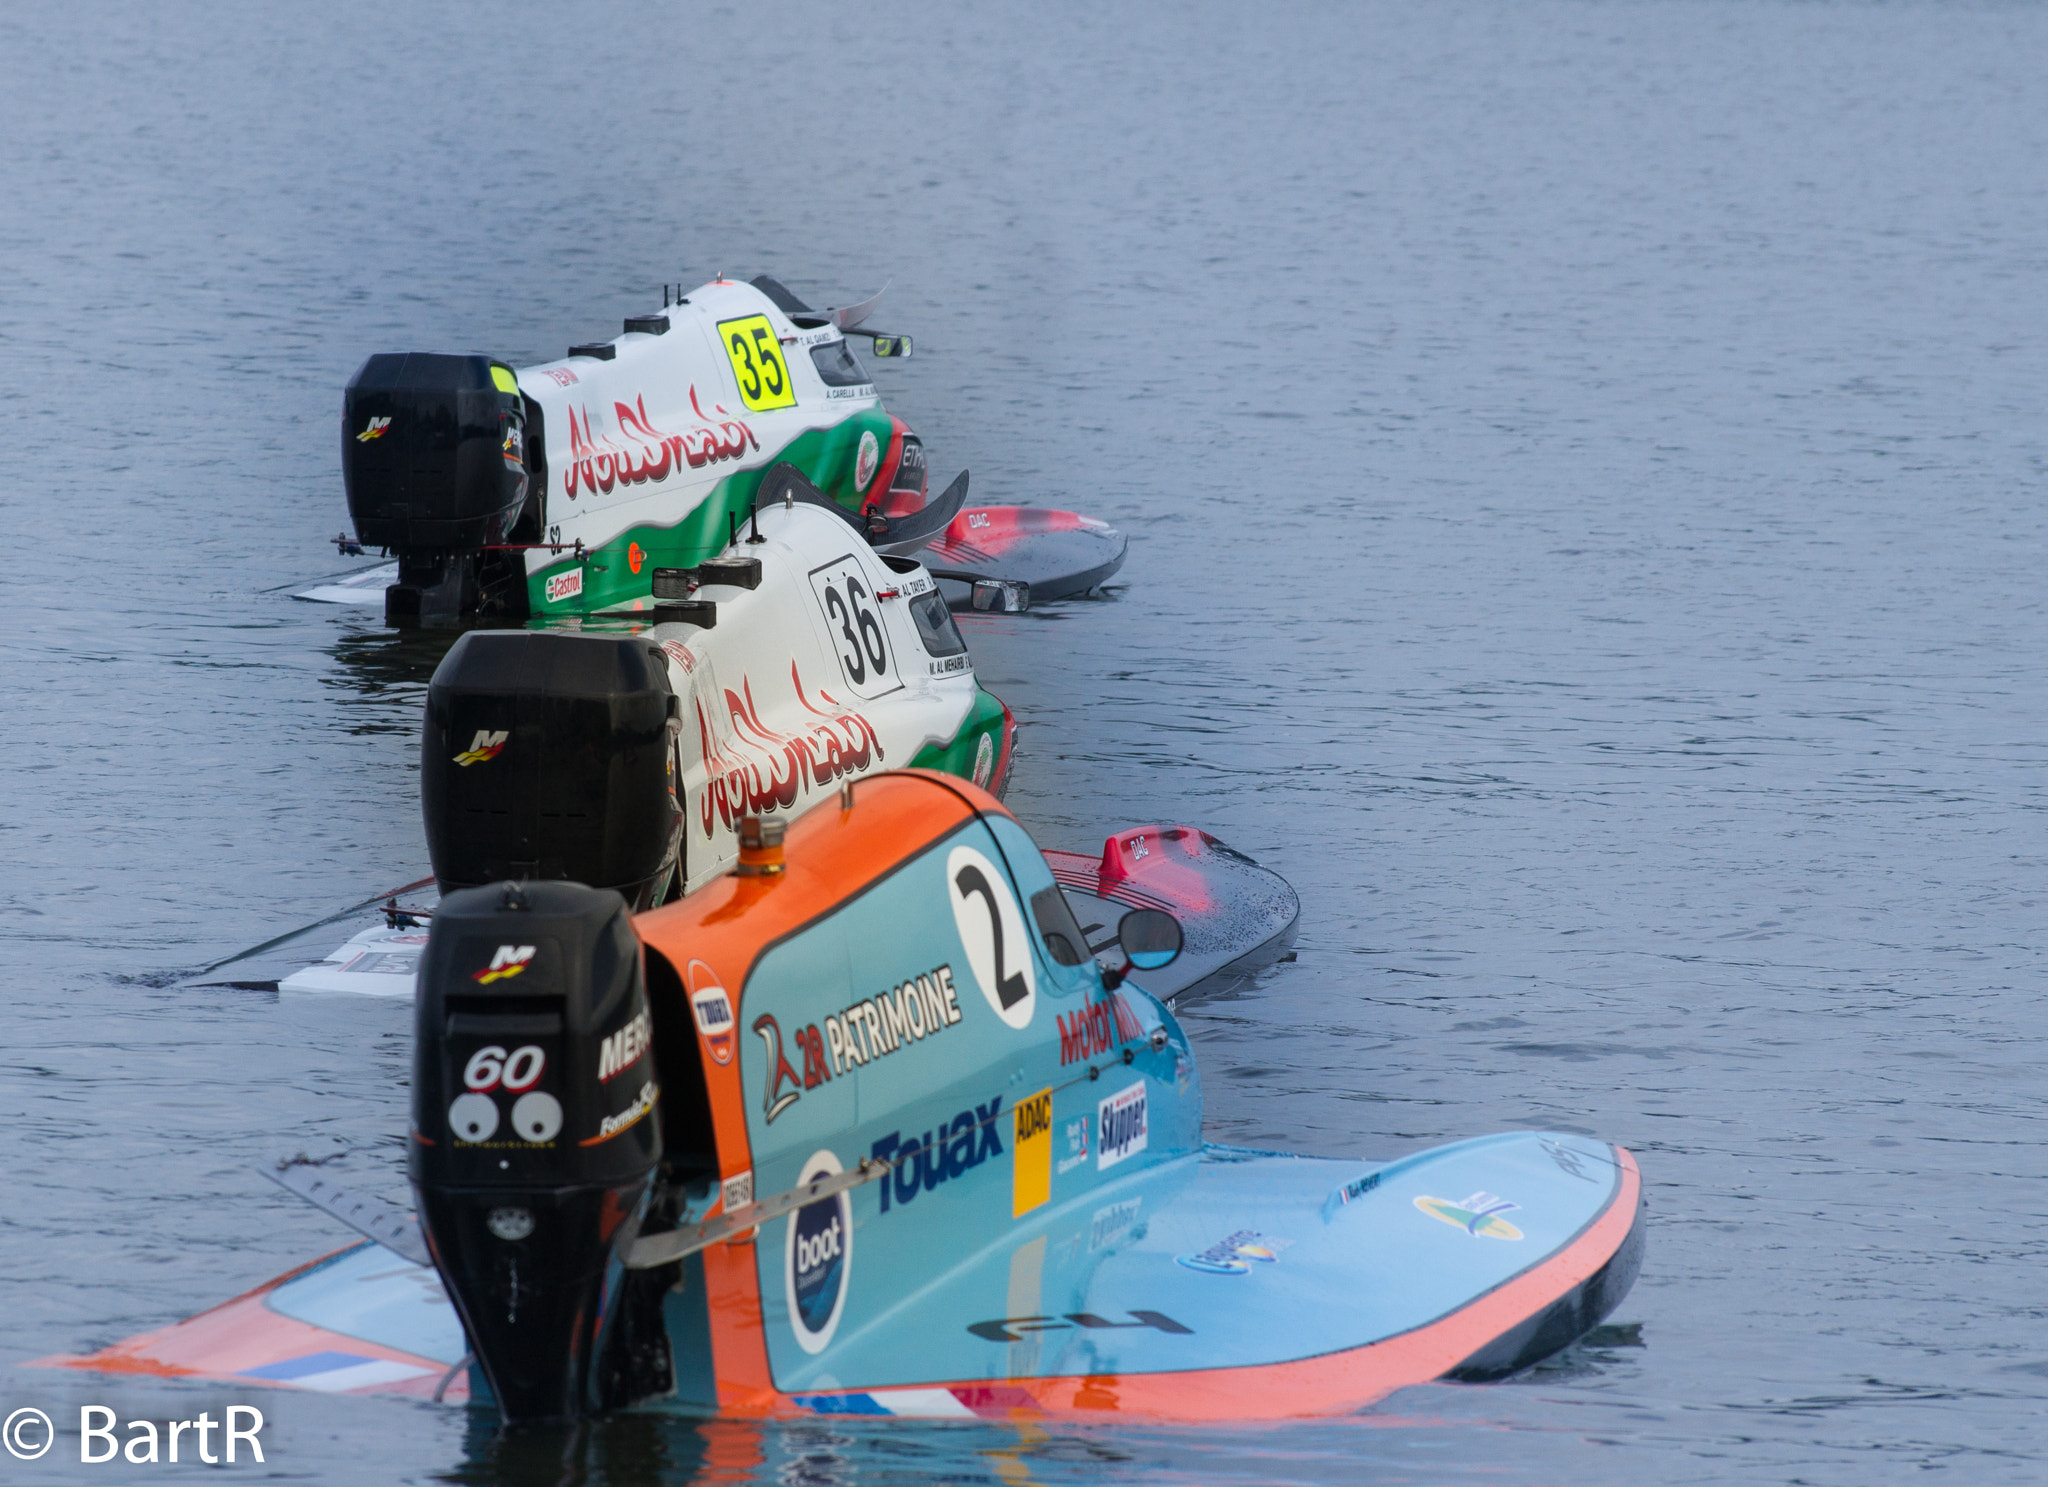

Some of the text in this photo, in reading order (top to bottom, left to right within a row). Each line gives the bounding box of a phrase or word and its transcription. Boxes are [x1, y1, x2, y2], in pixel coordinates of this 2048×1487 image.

[730, 327, 784, 401] 35
[968, 512, 990, 529] DAC
[554, 570, 581, 598] Castrol
[824, 575, 887, 686] 36
[1130, 834, 1149, 861] DAC
[955, 864, 1030, 1012] 2
[795, 962, 963, 1091] 2R PATRIMOINE
[463, 1045, 547, 1094] 60
[1015, 1093, 1051, 1145] ADAC
[871, 1095, 1004, 1216] Touax
[797, 1215, 841, 1274] boot
